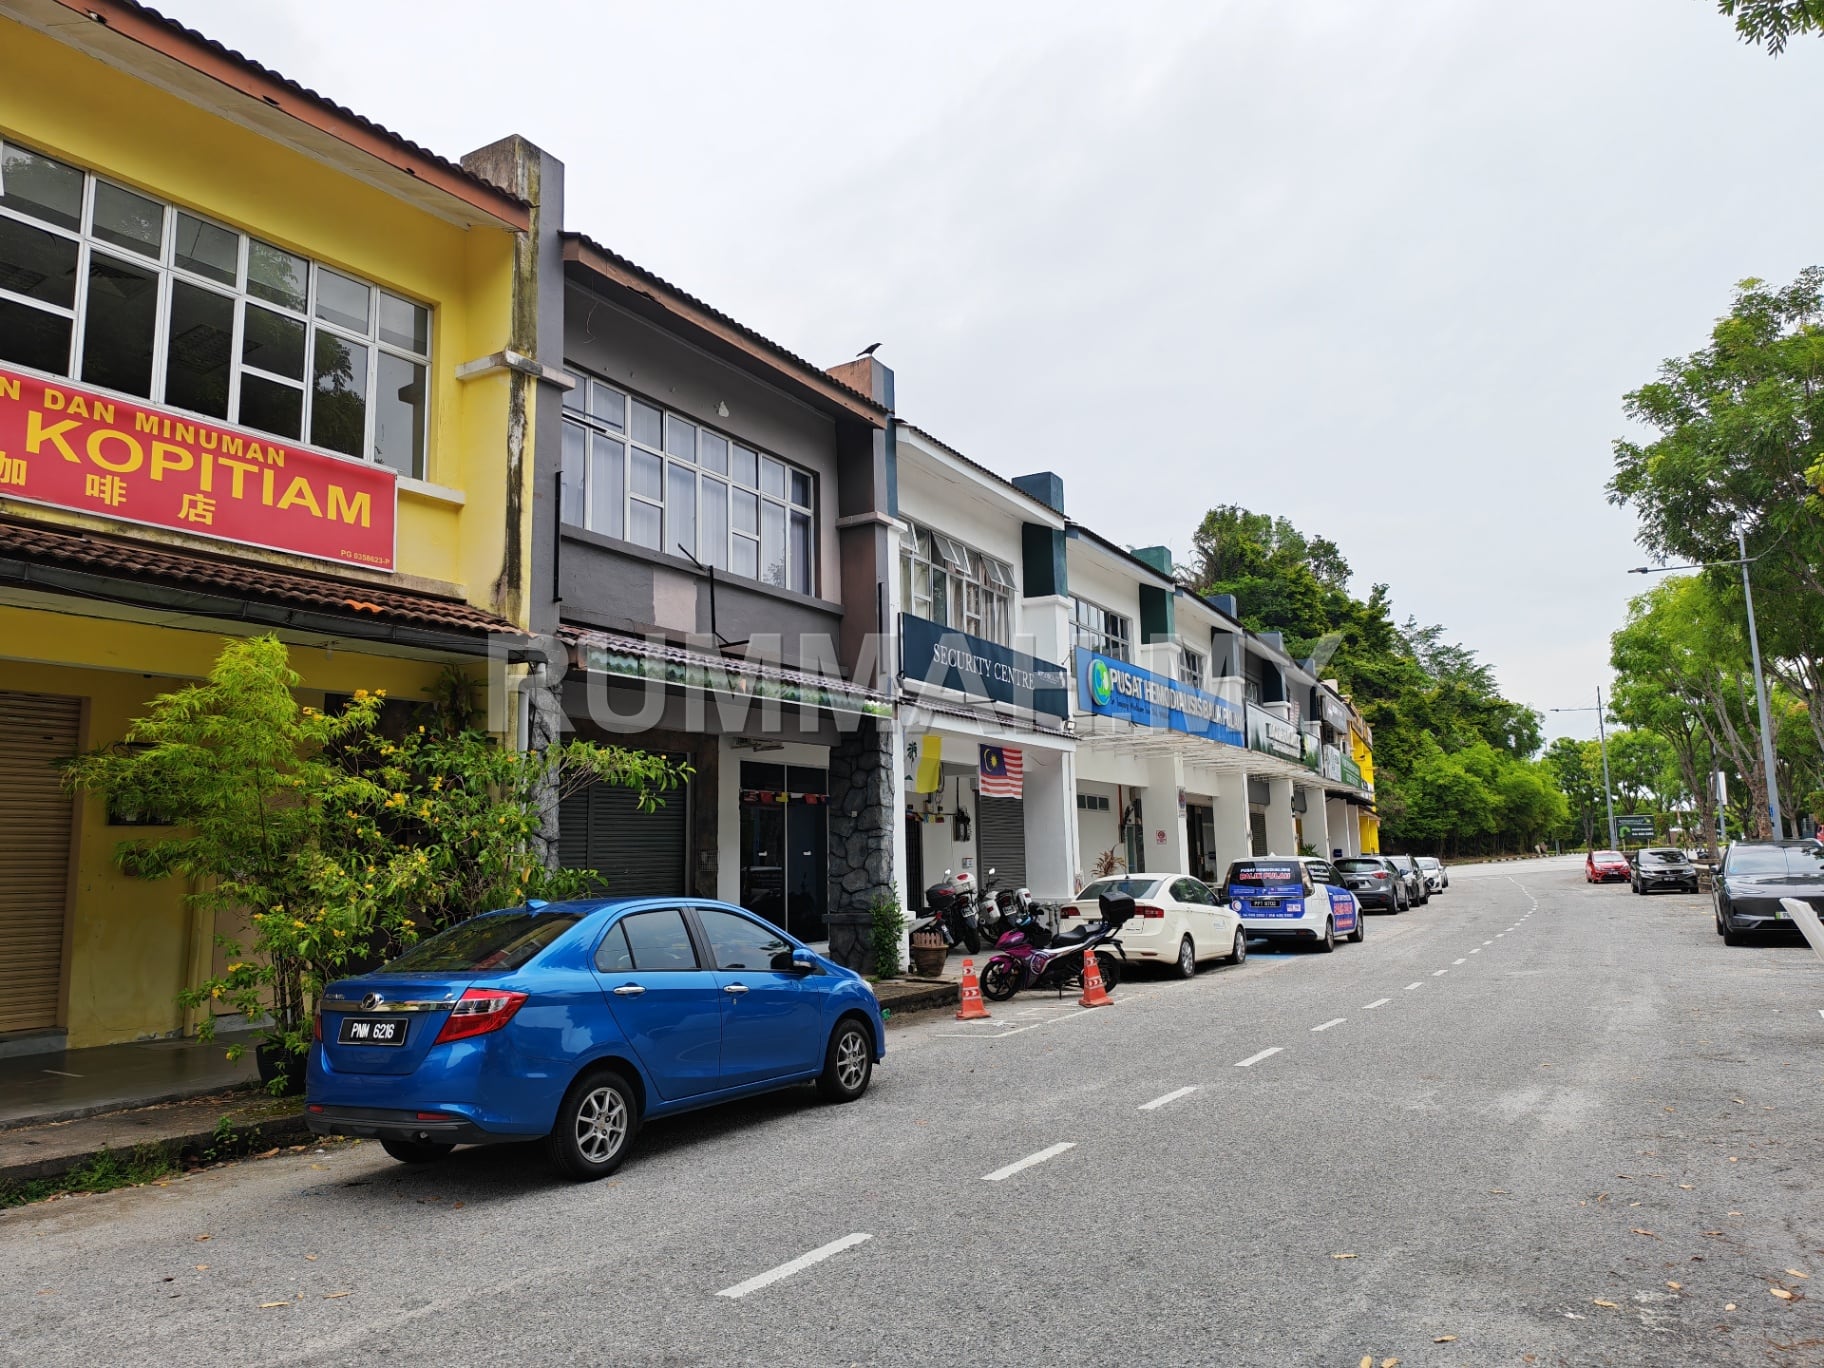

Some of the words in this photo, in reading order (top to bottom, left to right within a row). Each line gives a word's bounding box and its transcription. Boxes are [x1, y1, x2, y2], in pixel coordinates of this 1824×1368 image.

[44, 388, 115, 425] DAN
[135, 412, 285, 468] MINUMAN
[26, 410, 371, 528] KOPITIAM
[340, 549, 352, 559] PG
[933, 643, 992, 678] SECURITY
[994, 662, 1036, 690] CENTRE
[1109, 668, 1143, 699] PUSAT
[1143, 680, 1202, 718] HEMODIALISIS
[350, 1023, 370, 1038] PNM
[373, 1023, 395, 1038] 6216
